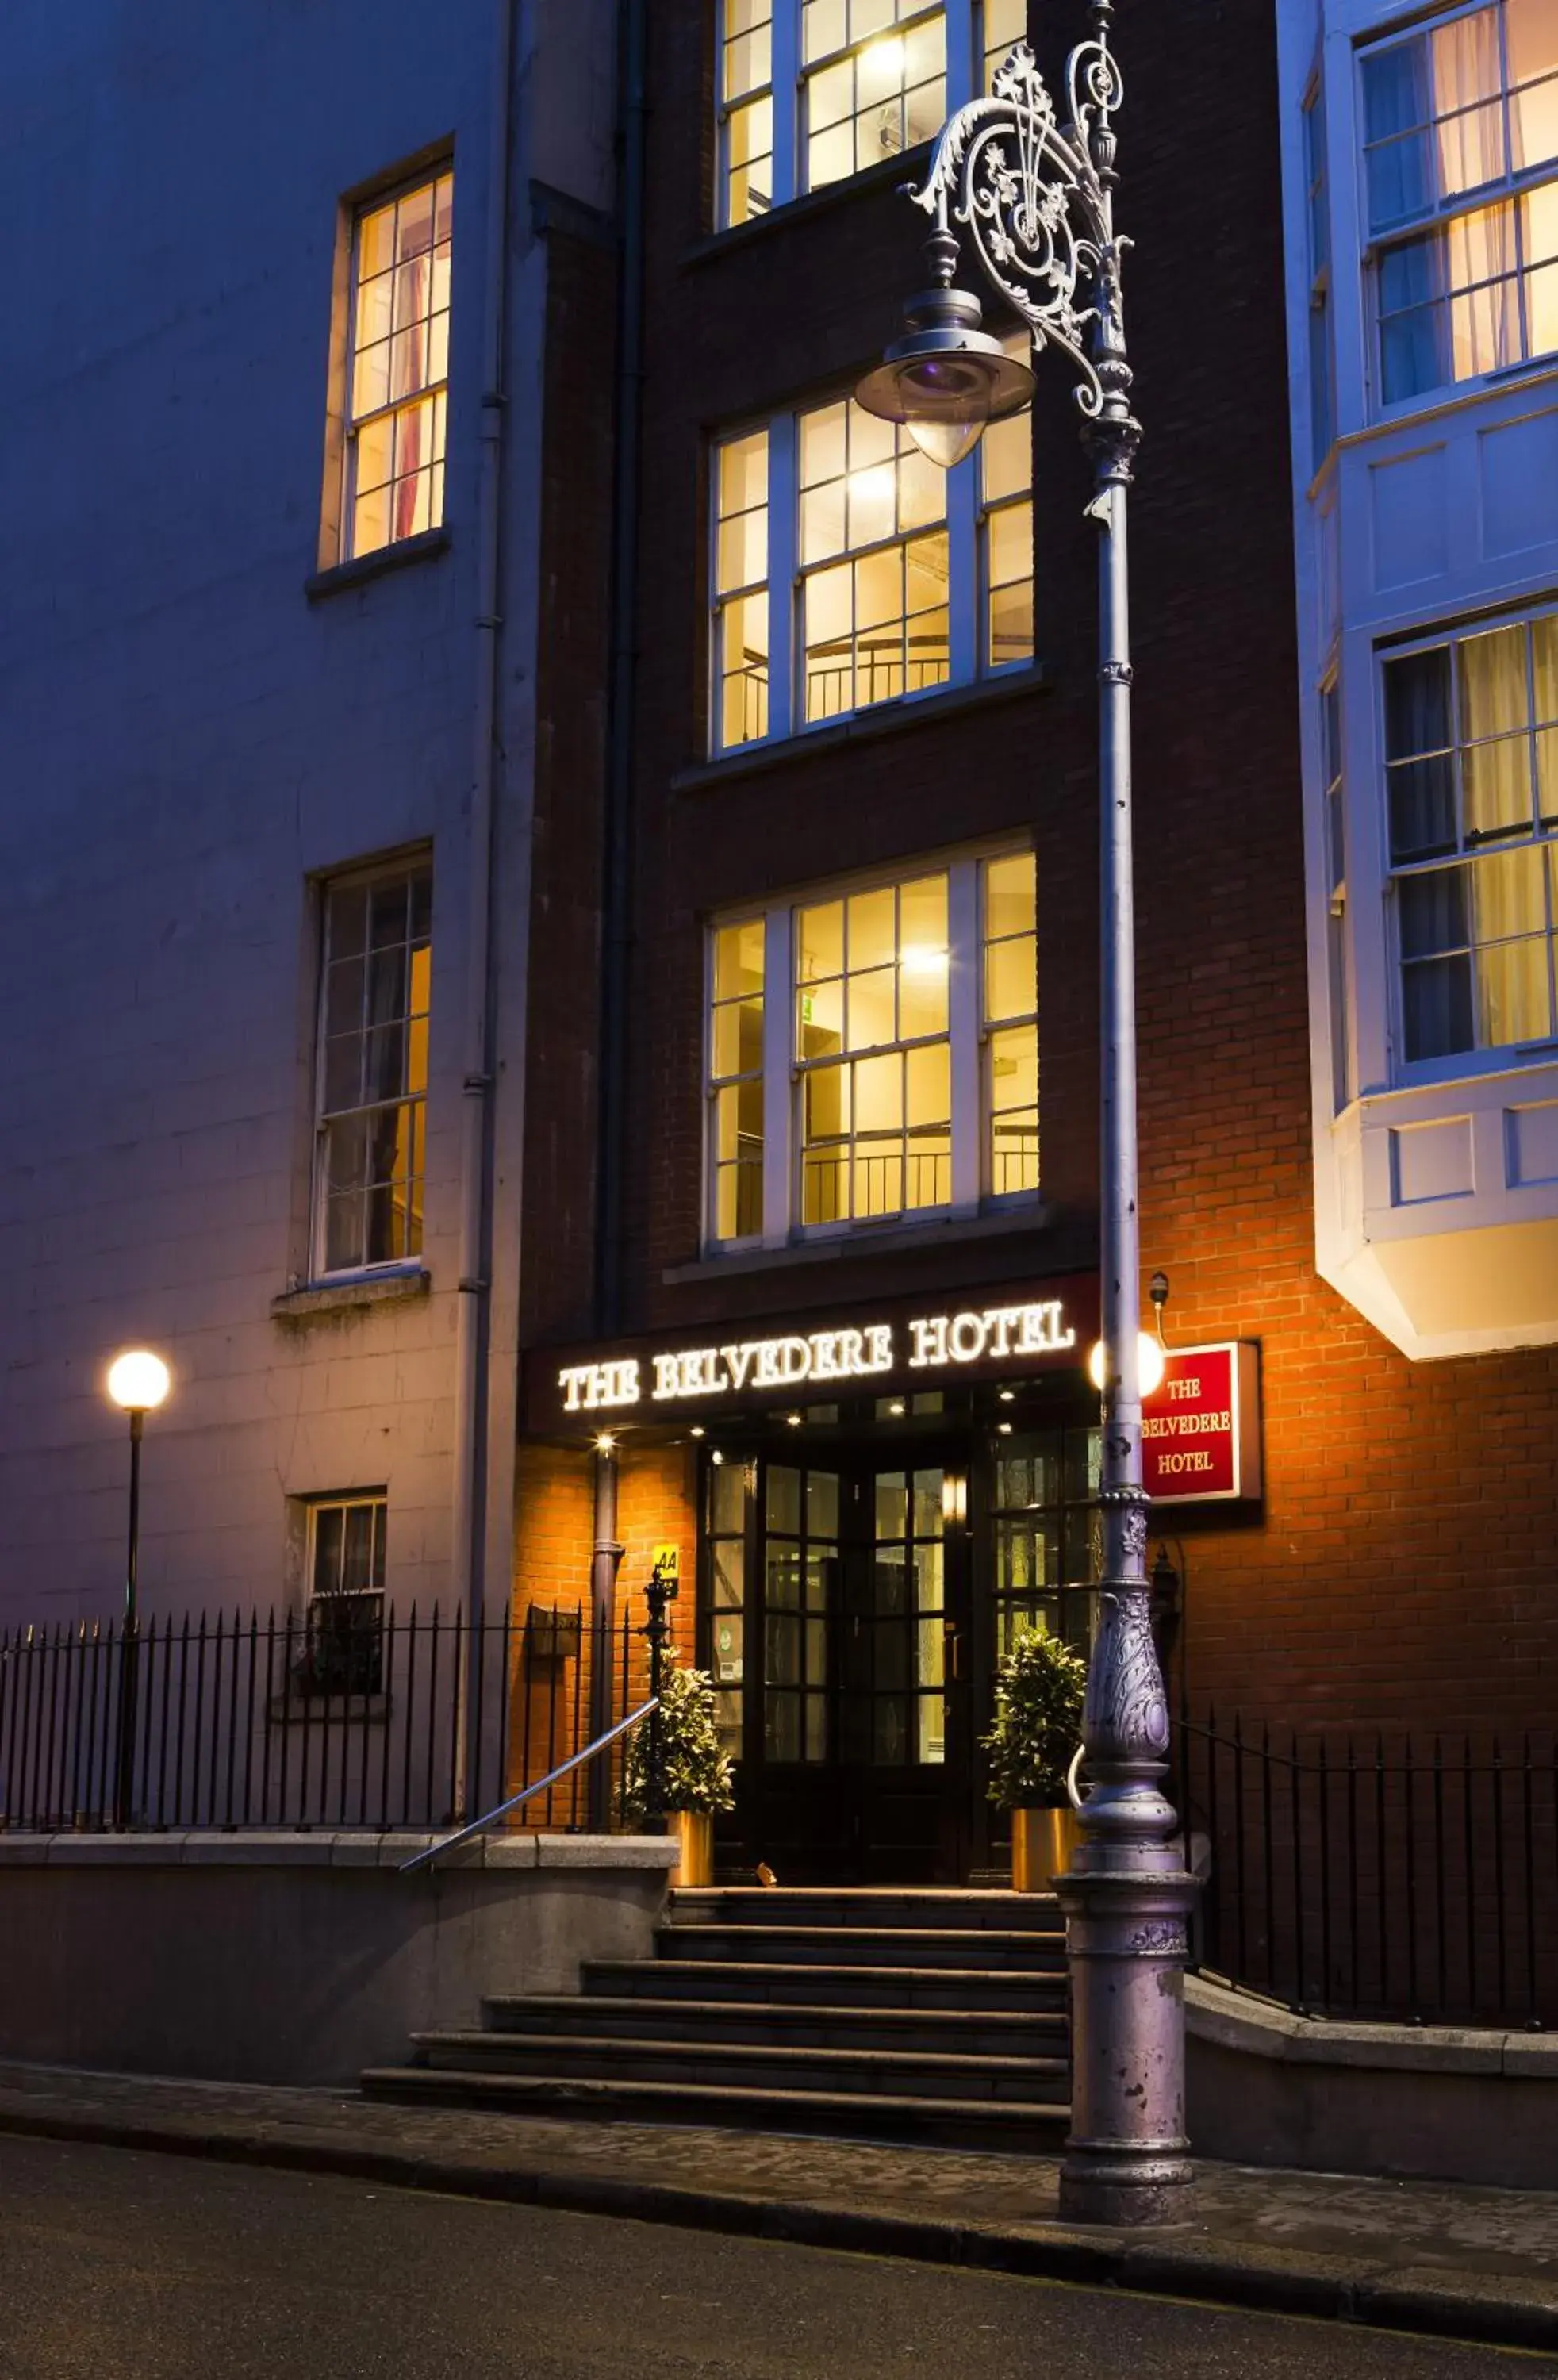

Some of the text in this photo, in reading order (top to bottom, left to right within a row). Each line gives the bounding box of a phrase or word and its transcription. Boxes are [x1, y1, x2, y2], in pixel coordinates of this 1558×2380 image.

[558, 1300, 1076, 1411] THE BELVEDERE HOTEL
[1167, 1378, 1201, 1400] THE
[1142, 1411, 1231, 1438] BELVEDERE
[1157, 1451, 1215, 1475] HOTEL
[658, 1551, 676, 1570] AA
